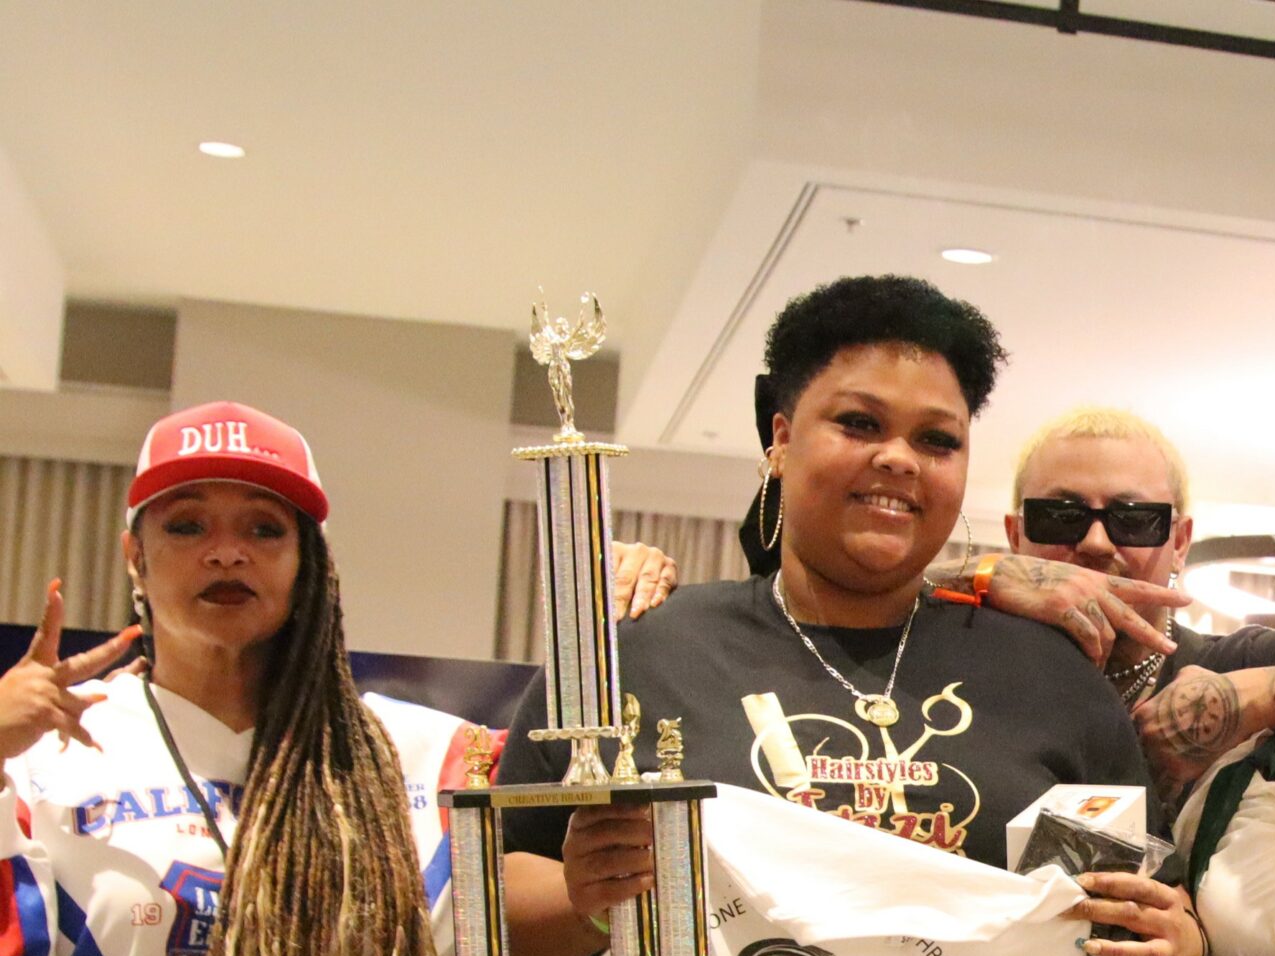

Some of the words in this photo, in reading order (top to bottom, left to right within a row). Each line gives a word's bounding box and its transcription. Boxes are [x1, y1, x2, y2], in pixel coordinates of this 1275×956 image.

[808, 756, 935, 785] Hairstyles
[72, 777, 244, 835] CALIF
[856, 783, 888, 811] by
[131, 903, 162, 926] 19
